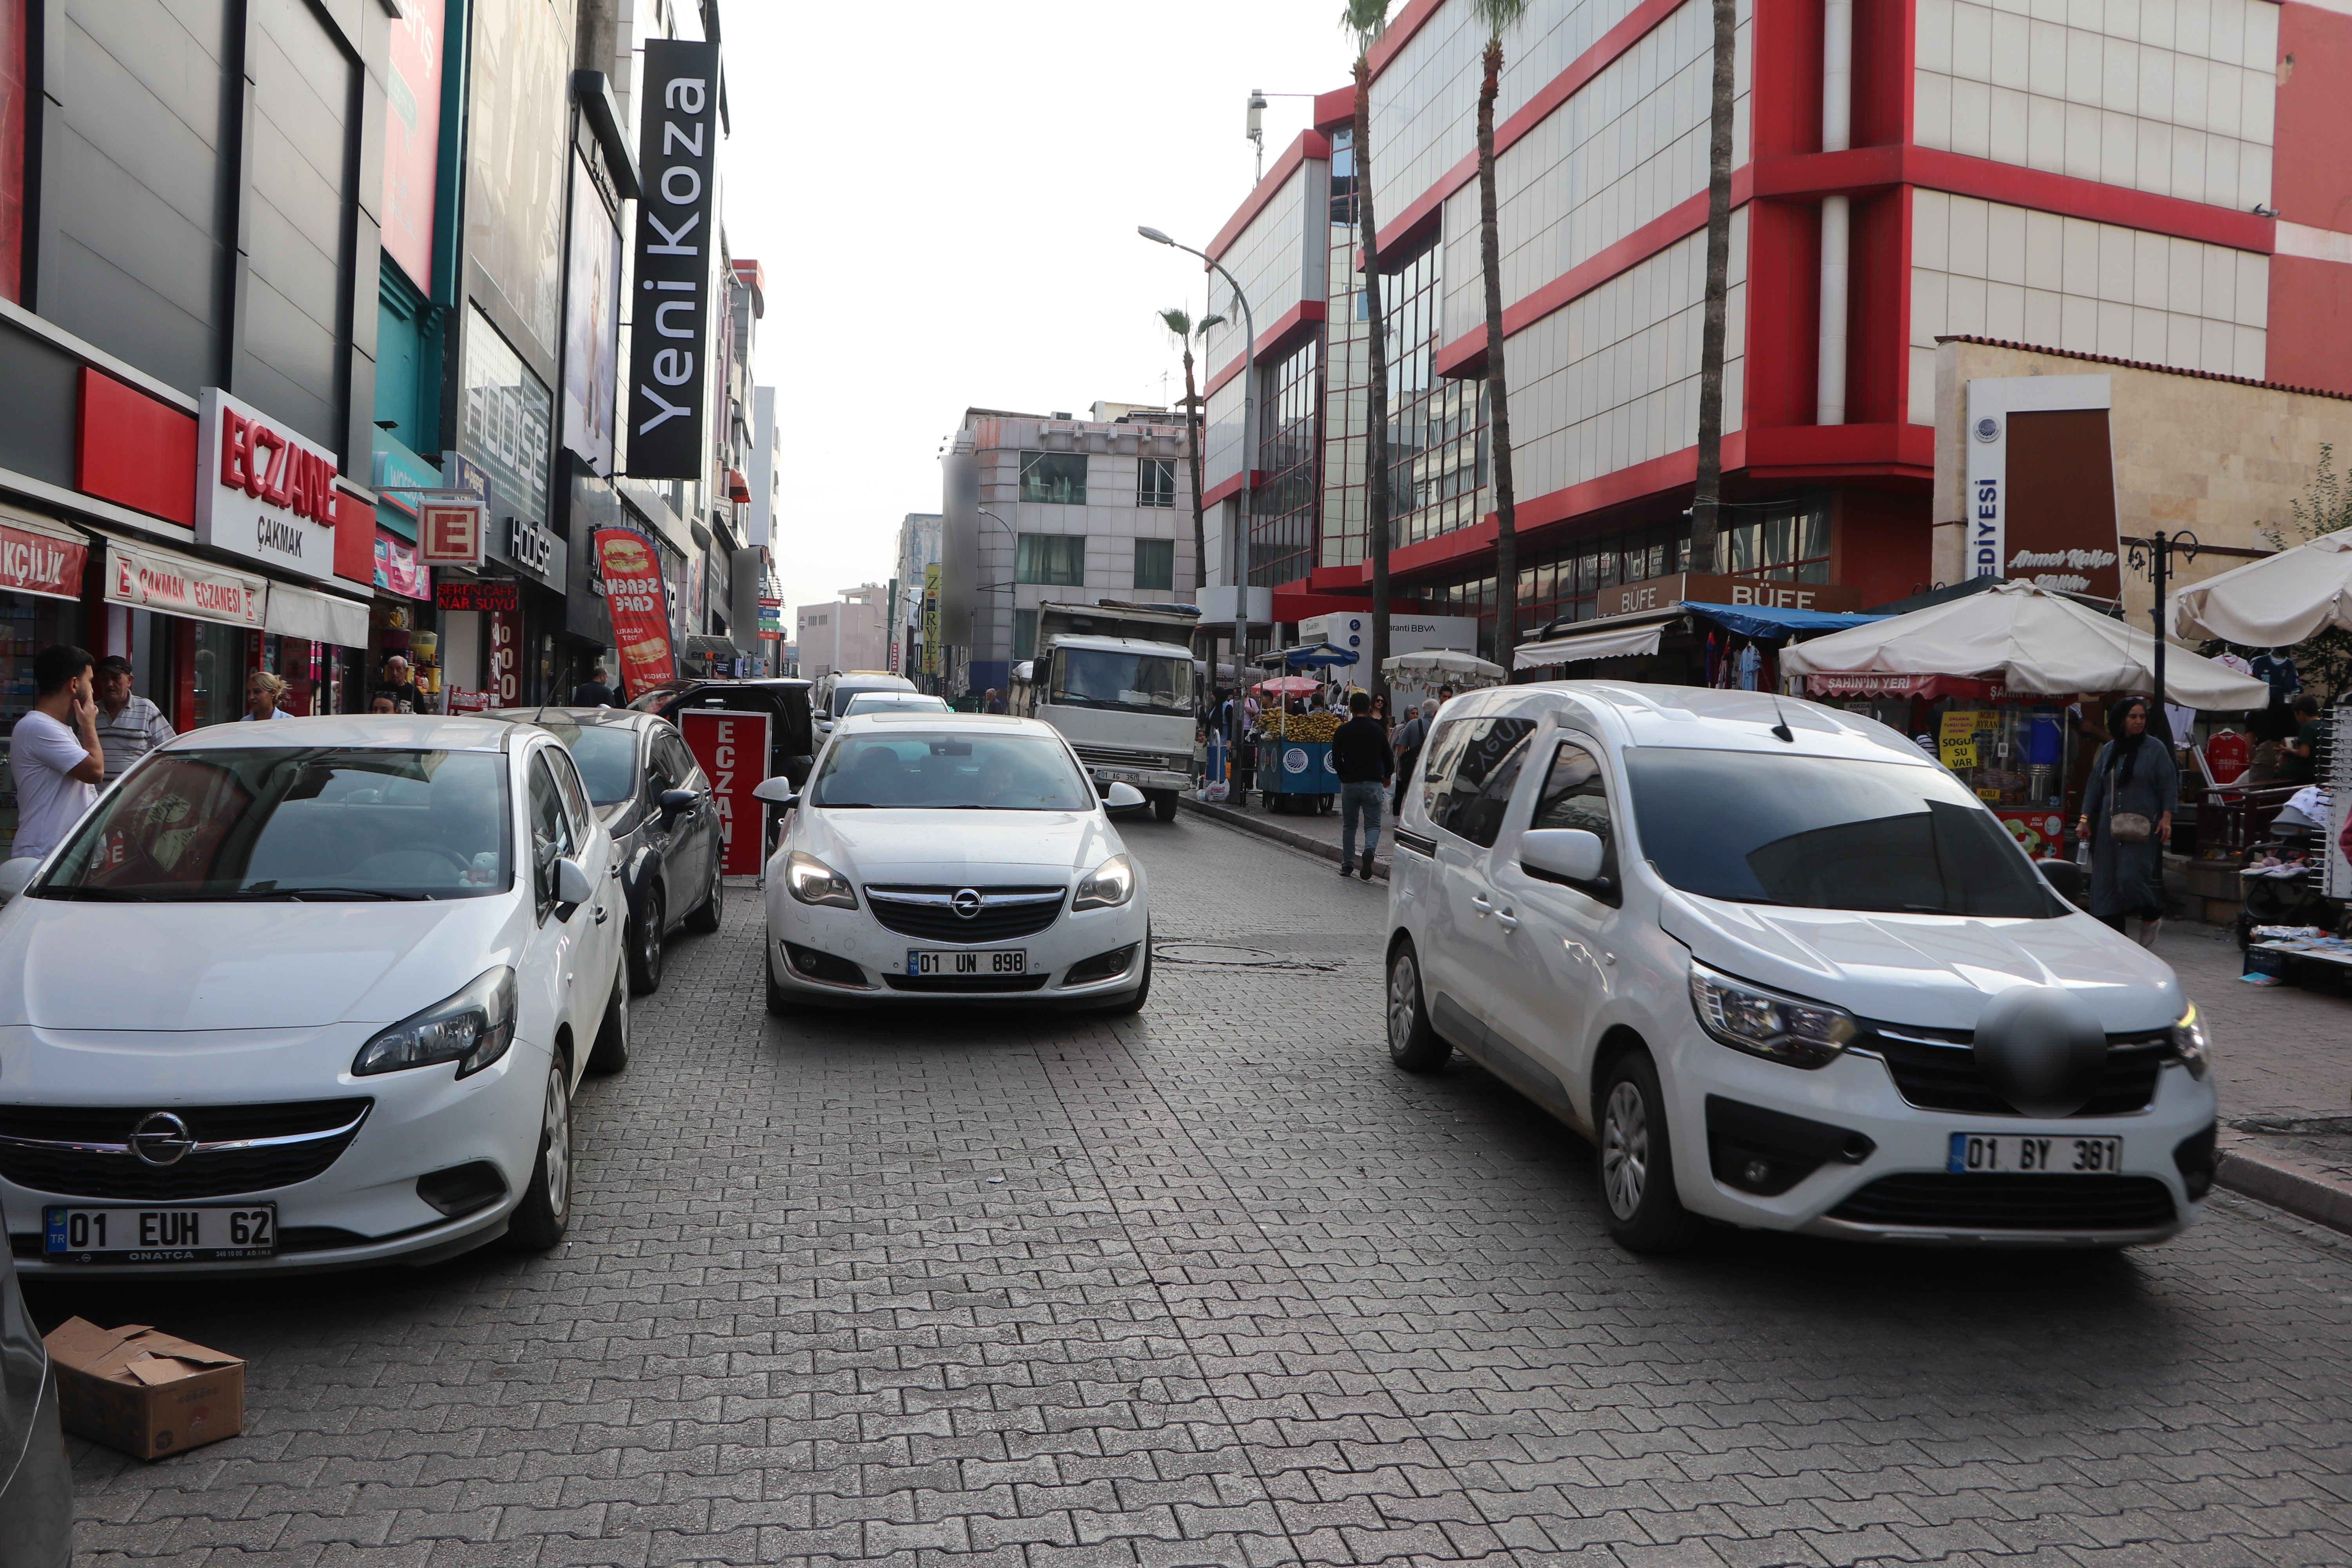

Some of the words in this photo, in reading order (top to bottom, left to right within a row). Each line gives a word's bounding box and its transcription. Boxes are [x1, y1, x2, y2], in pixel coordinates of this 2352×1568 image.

[401, 0, 433, 79] eriş
[647, 78, 705, 256] Koza
[639, 280, 696, 436] Yeni
[221, 405, 338, 528] ECZANE
[258, 515, 303, 558] ÇAKMAK
[434, 514, 468, 553] E
[1974, 479, 1996, 576] EDİYESİ
[2, 539, 65, 586] KÇİLİK
[2007, 550, 2067, 569] Ahmet
[2066, 549, 2117, 570] Kalfa
[139, 568, 188, 603] ÇAKMAK
[193, 581, 241, 613] ECZANESİ
[438, 584, 481, 596] SEREN
[439, 597, 470, 609] NAR
[475, 598, 515, 610] SUYU
[1621, 586, 1657, 613] BÜFE
[1733, 582, 1815, 612] BÜFE
[1882, 675, 1911, 689] YERİ
[1952, 758, 1972, 767] VAR
[1955, 748, 1967, 756] SU
[921, 954, 939, 973] 01
[956, 954, 976, 972] UN
[993, 953, 1023, 972] 898
[1967, 1138, 1997, 1169] 01
[2020, 1138, 2051, 1170] BY
[51, 1234, 65, 1243] TR
[70, 1213, 106, 1247] 01
[140, 1212, 199, 1246] EUH
[230, 1210, 270, 1244] 62
